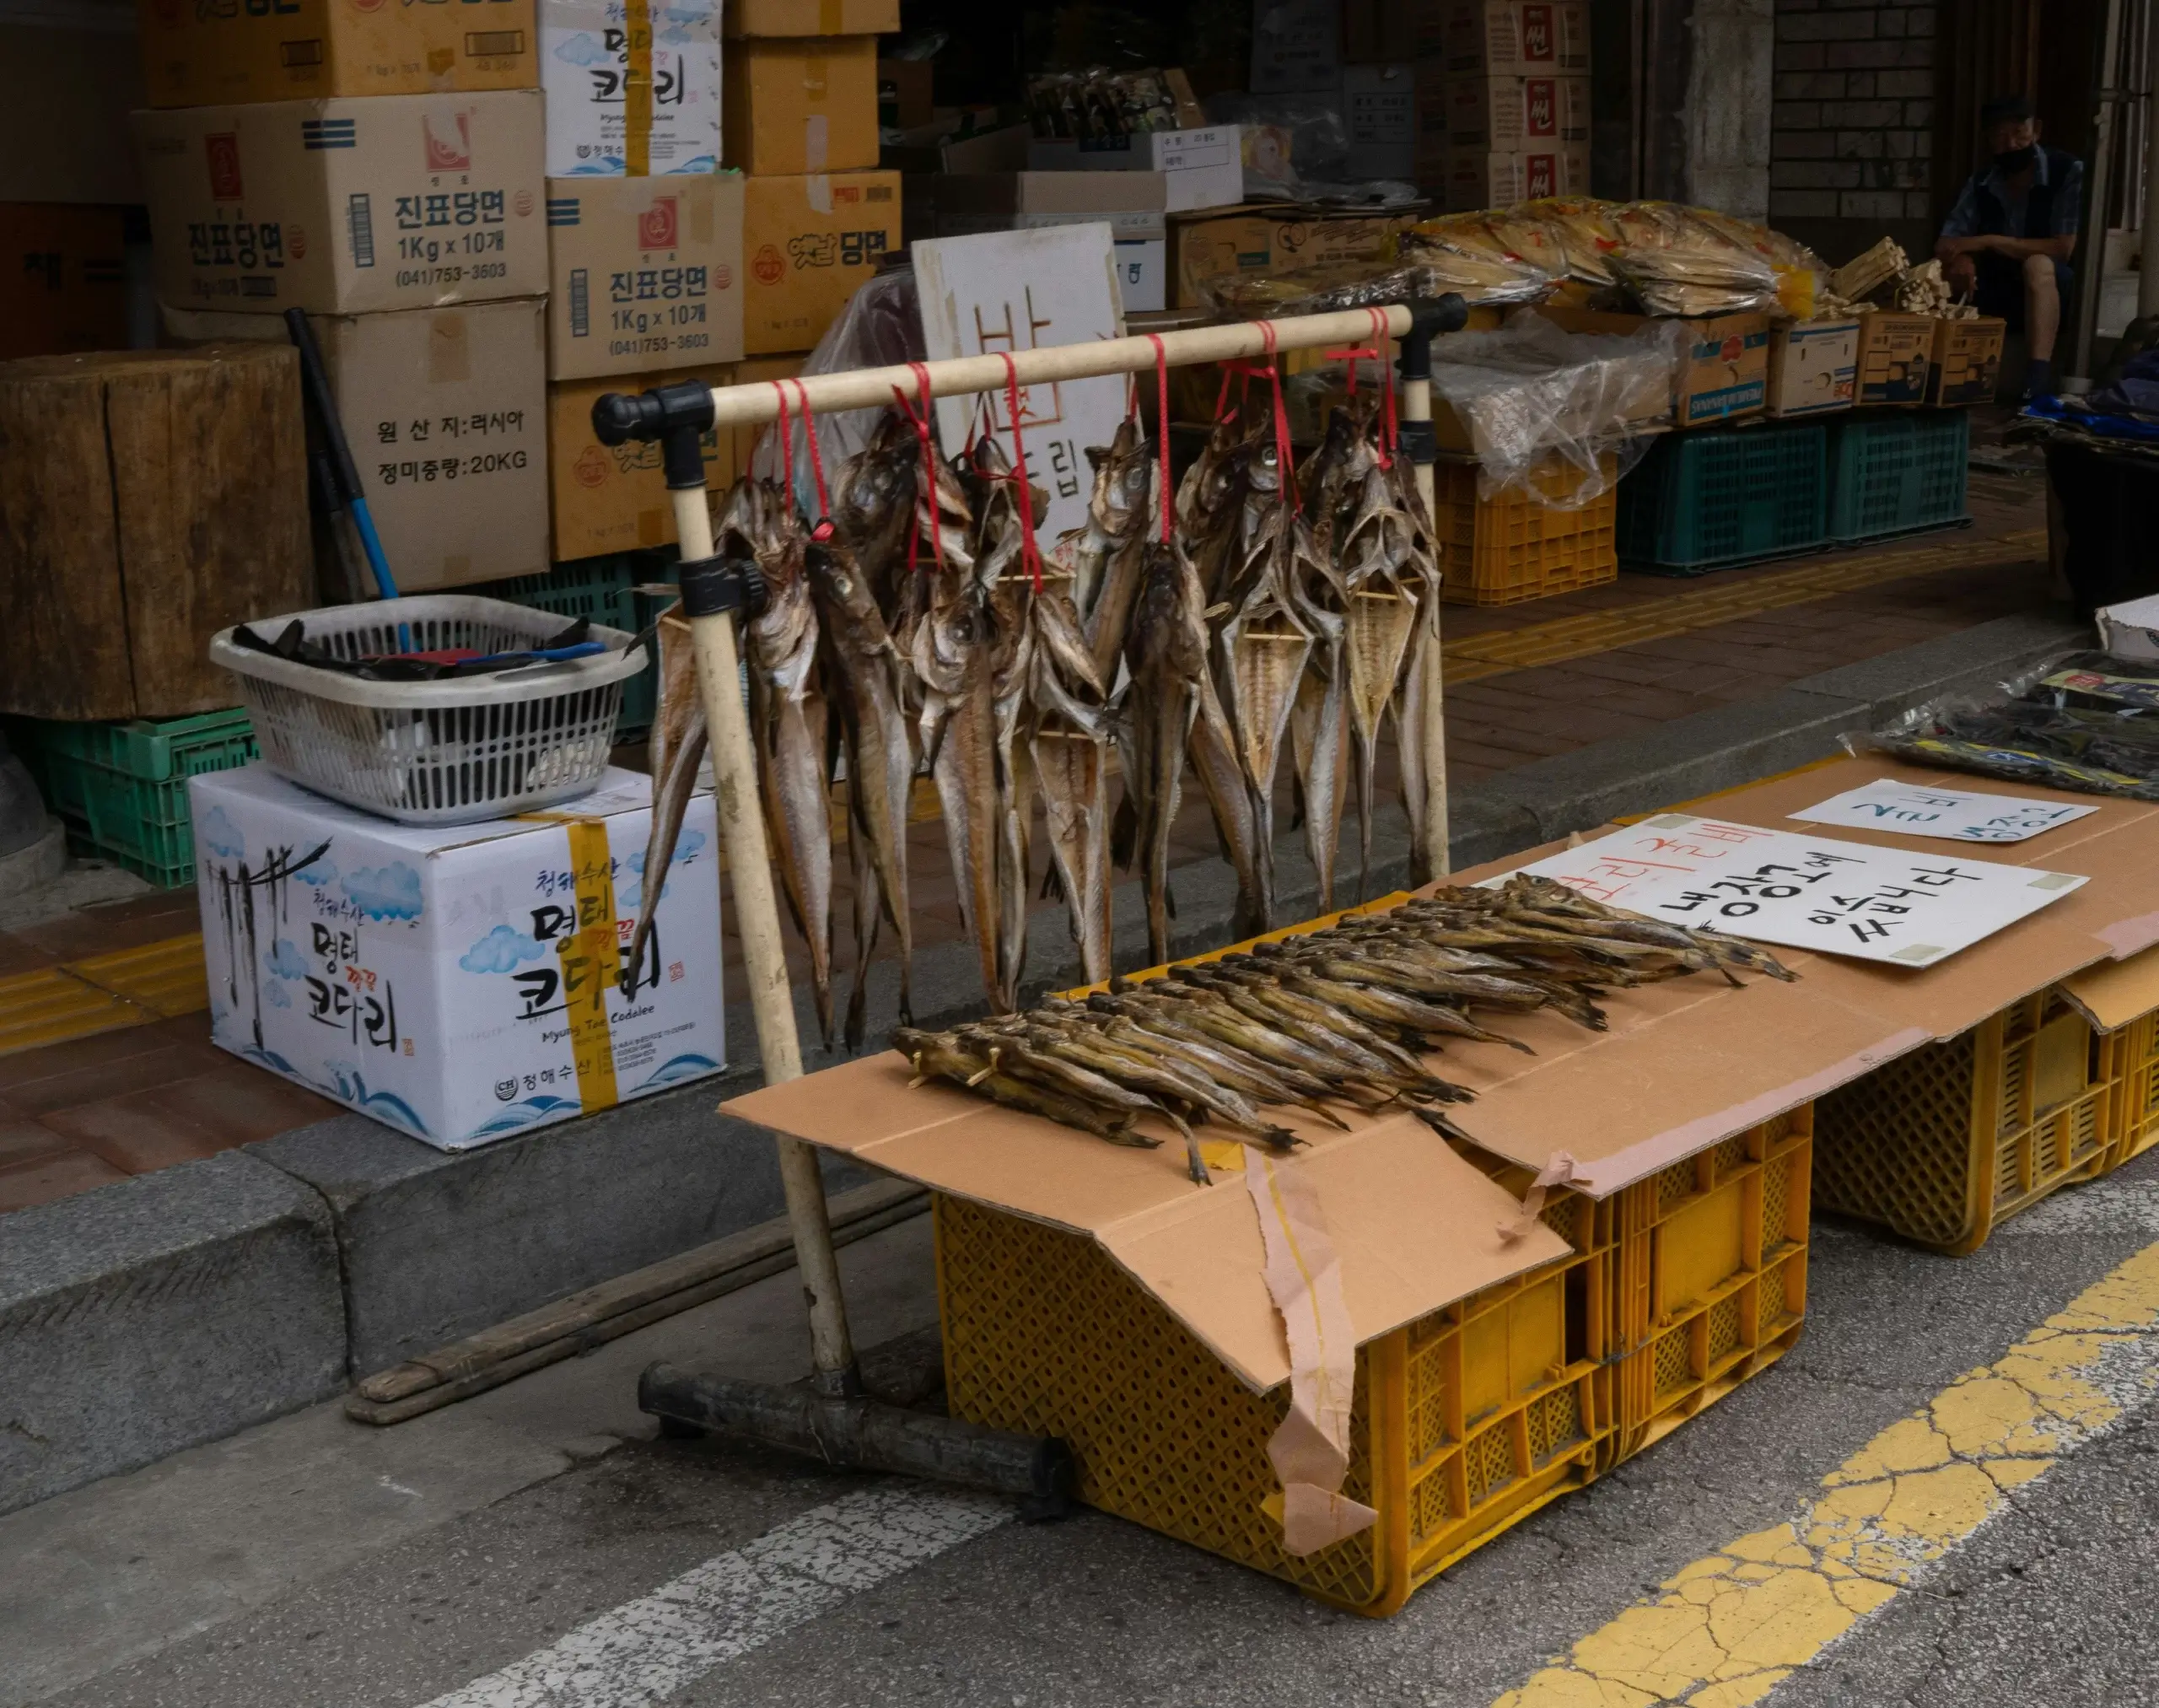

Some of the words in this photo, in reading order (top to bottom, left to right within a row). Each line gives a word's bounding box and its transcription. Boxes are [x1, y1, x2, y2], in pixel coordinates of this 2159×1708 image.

[396, 190, 504, 230] 진표당면
[188, 223, 284, 269] 진표당면
[398, 236, 439, 262] 1Kg
[462, 229, 504, 255] 10개
[396, 262, 506, 288] (041)753-3603
[610, 266, 707, 303] 진표당면
[611, 310, 648, 333] 1Kg
[669, 303, 706, 326] 10개
[1659, 851, 1867, 918] 냉장고에
[1807, 867, 1984, 943] 있습니다
[310, 922, 359, 975] 명태
[304, 974, 397, 1053] 코다리
[610, 1005, 655, 1025] Codalee
